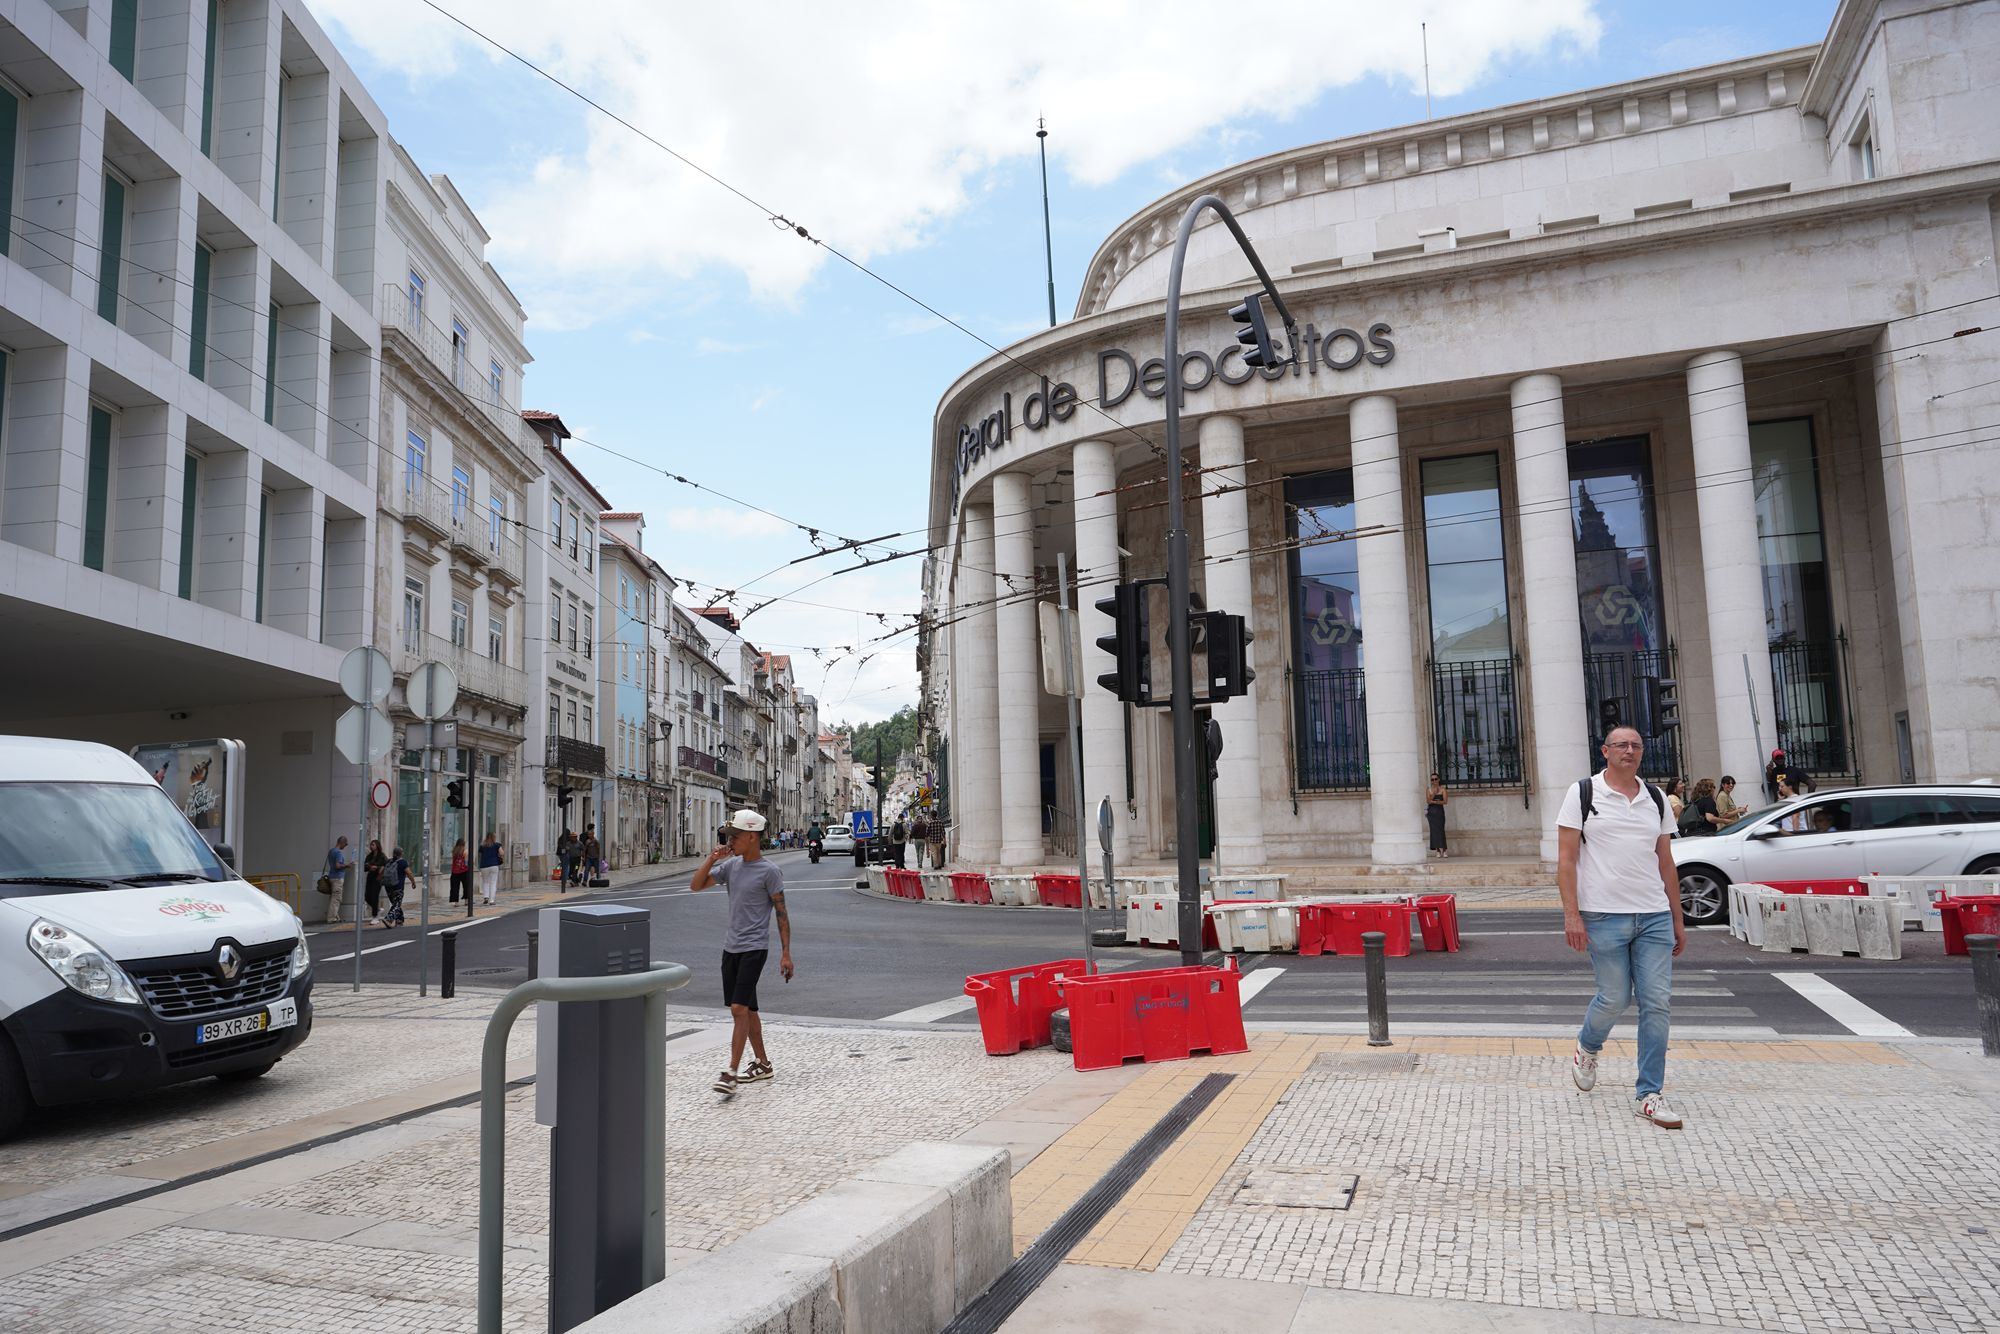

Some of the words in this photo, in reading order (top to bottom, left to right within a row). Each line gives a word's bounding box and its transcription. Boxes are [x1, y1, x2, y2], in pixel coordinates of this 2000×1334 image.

[957, 391, 1011, 475] Geral
[1023, 375, 1077, 430] de
[281, 1007, 295, 1020] TP
